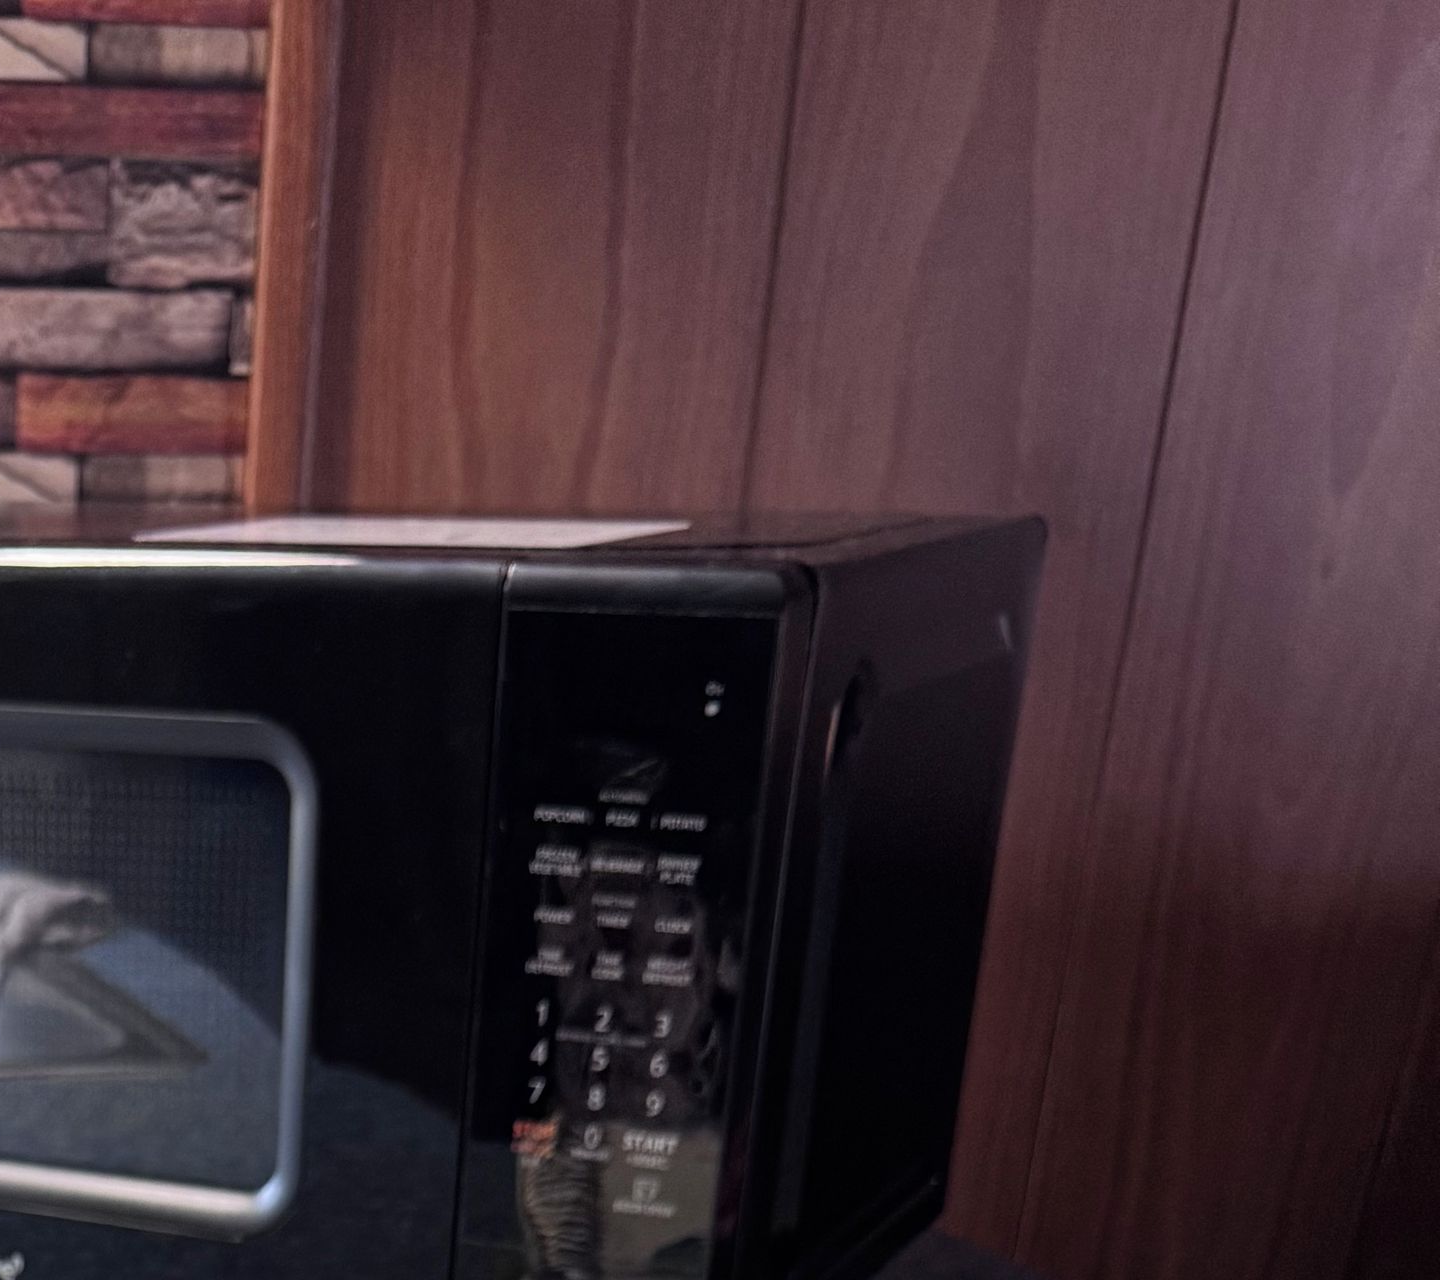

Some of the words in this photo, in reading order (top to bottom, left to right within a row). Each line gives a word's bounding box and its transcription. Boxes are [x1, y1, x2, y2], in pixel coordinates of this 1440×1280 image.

[536, 998, 549, 1027] 1
[594, 1003, 613, 1033] 2
[653, 1010, 672, 1038] 3
[529, 1037, 549, 1067] 4
[592, 1044, 609, 1072] 5
[650, 1050, 669, 1078] 6
[528, 1076, 546, 1104] 7
[587, 1082, 606, 1111] 8
[646, 1089, 665, 1117] 9
[583, 1123, 601, 1150] 0
[622, 1130, 679, 1154] START
